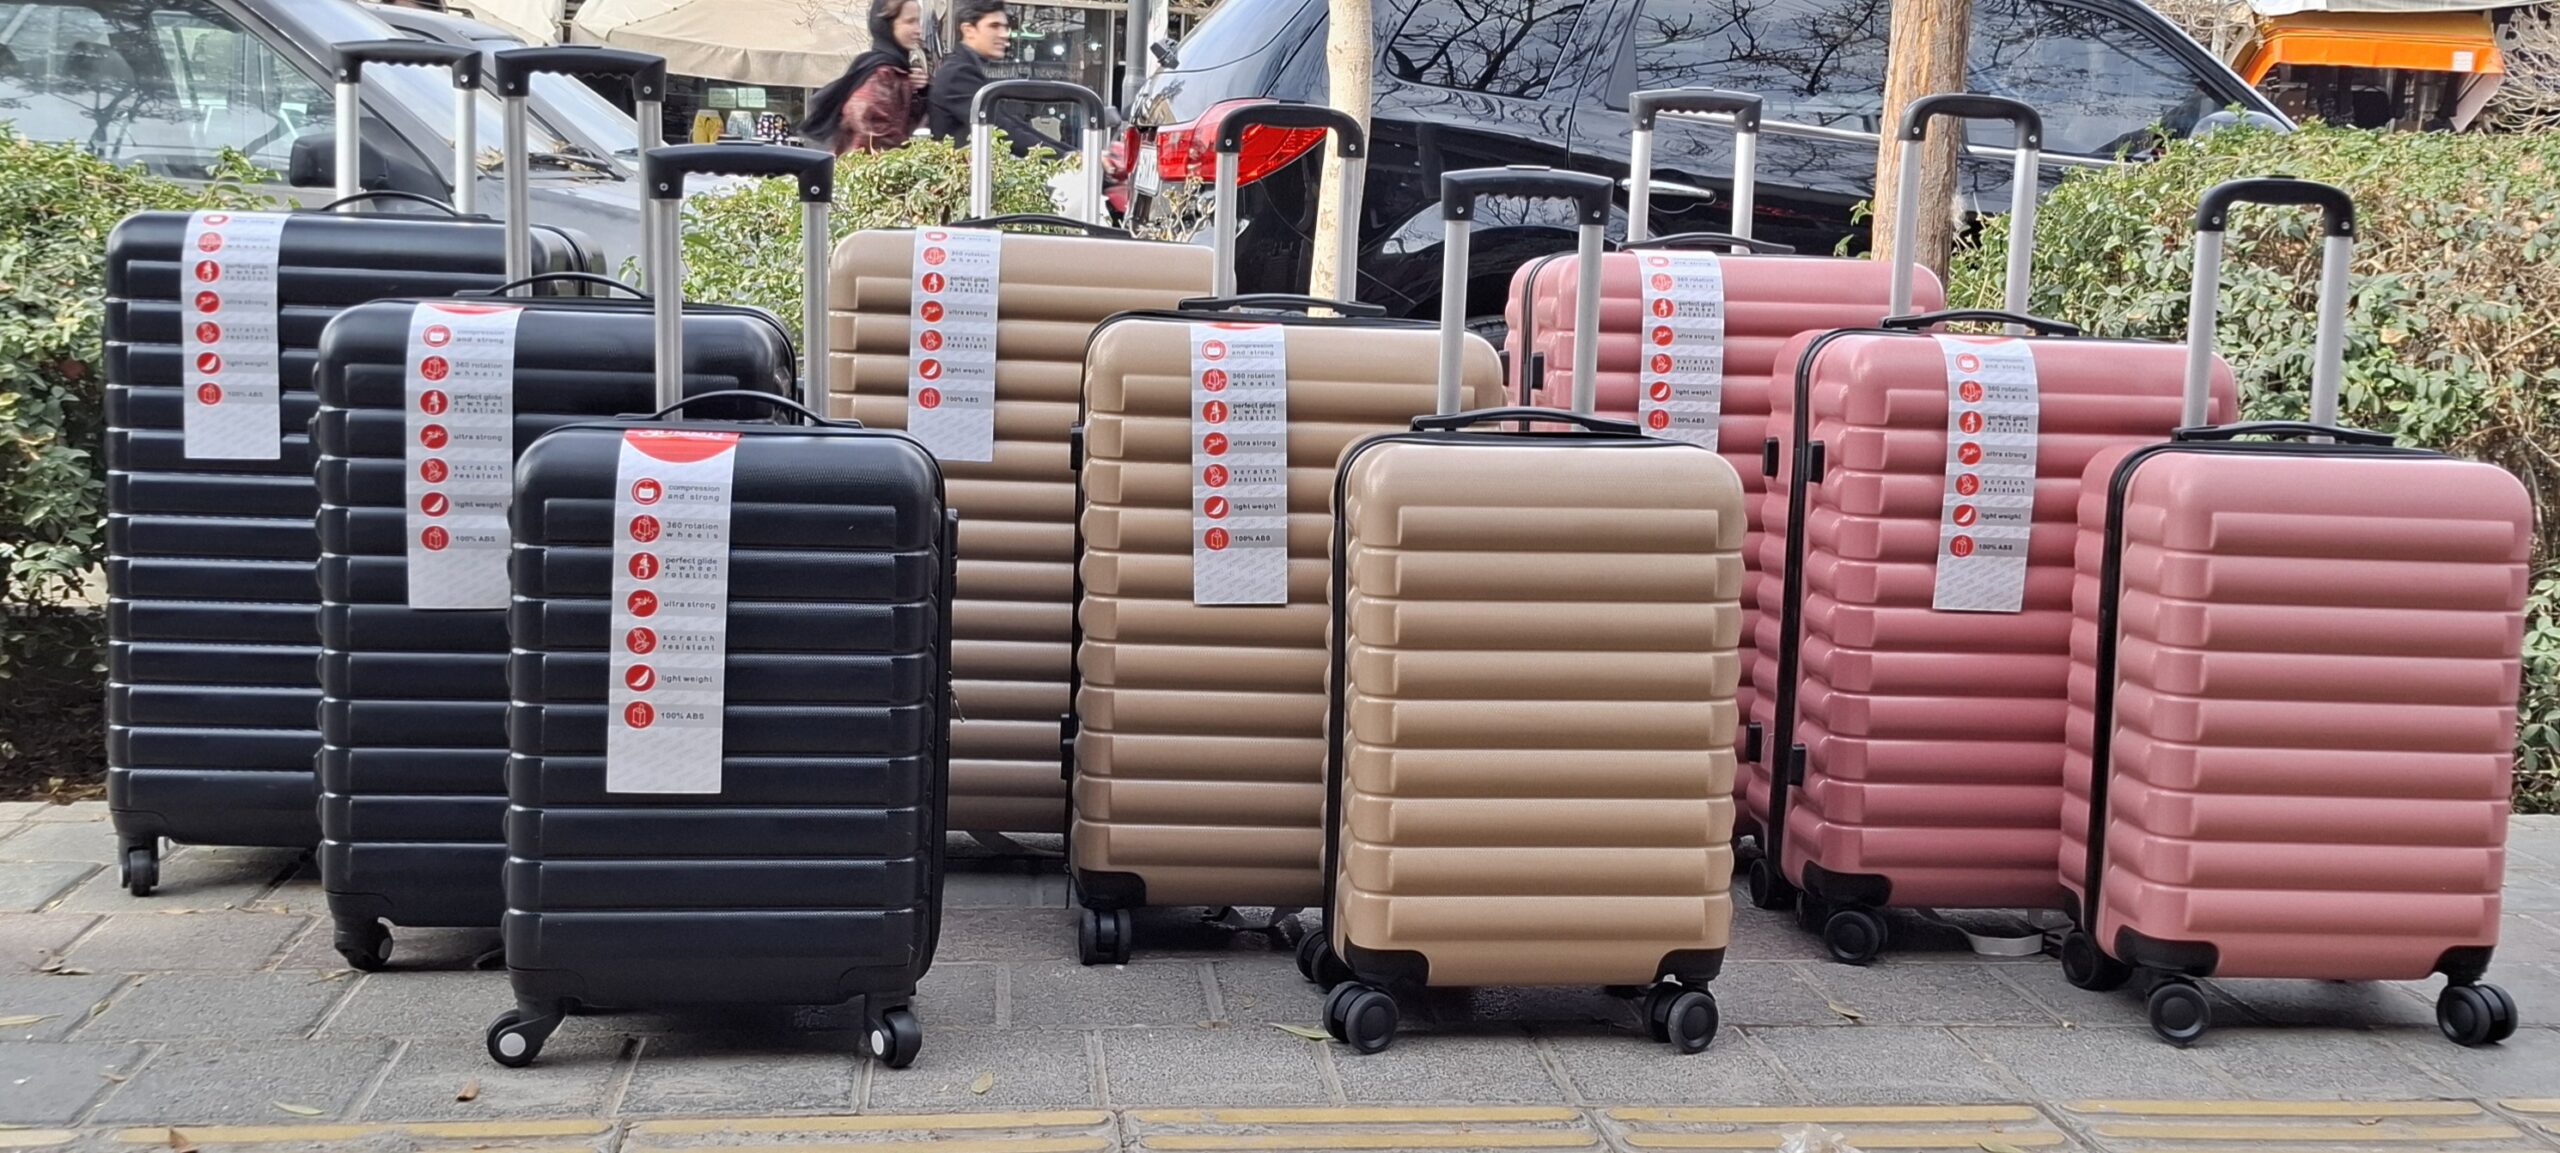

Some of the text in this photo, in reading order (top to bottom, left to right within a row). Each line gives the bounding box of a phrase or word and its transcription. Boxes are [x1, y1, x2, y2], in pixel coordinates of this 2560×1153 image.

[475, 434, 503, 442] strong
[2004, 451, 2027, 459] strong
[668, 484, 721, 492] compression
[689, 494, 720, 502] strong
[475, 501, 503, 509] weight
[1233, 503, 1277, 511] light weight
[666, 521, 718, 530] 360 rotation
[665, 557, 718, 566] perfect glide
[663, 600, 716, 610] ultra strong
[662, 634, 715, 642] scratch
[662, 643, 715, 651] resistant
[661, 674, 713, 684] light weight
[660, 712, 705, 720] 100% ABS
